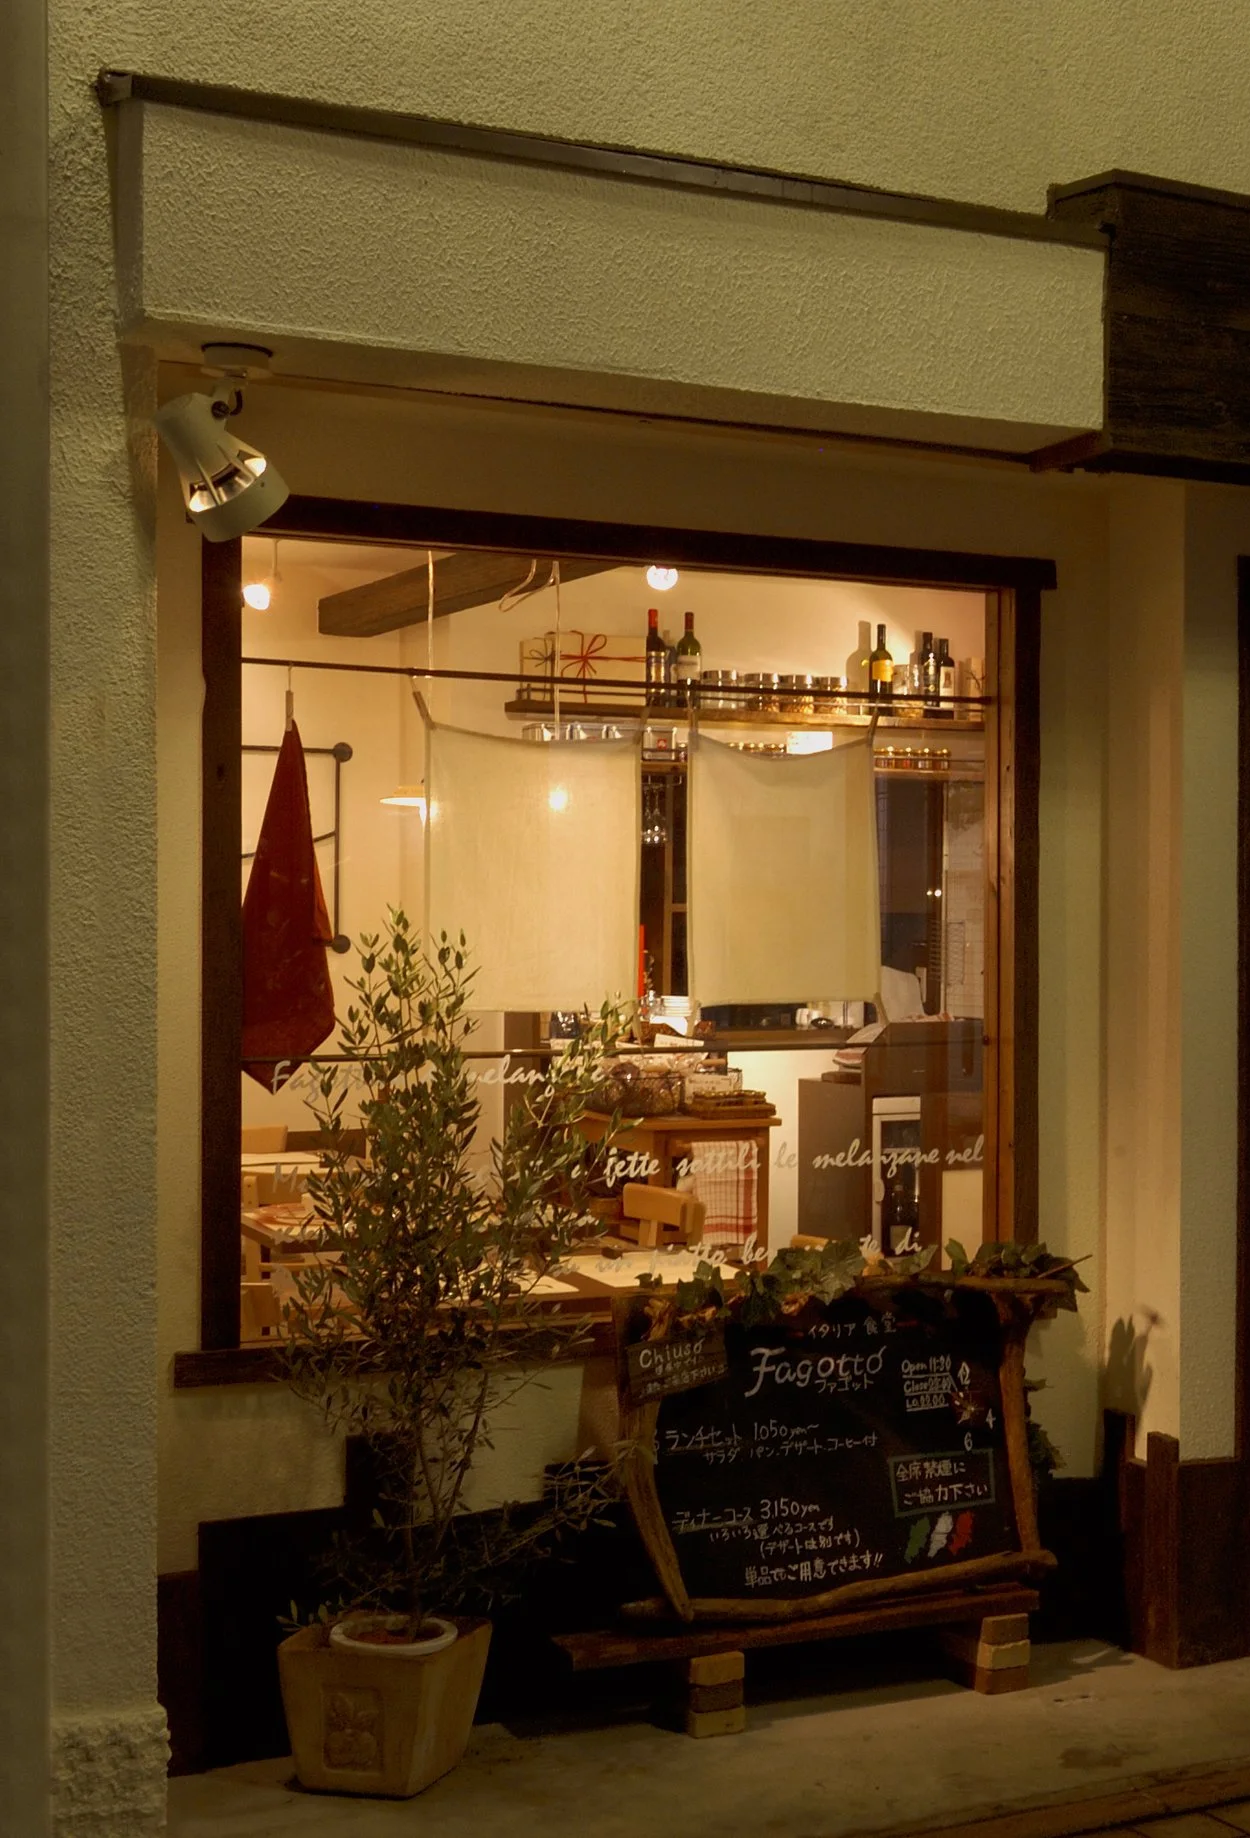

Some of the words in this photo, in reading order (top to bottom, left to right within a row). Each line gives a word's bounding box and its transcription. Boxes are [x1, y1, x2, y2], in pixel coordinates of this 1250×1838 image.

[812, 1138, 940, 1178] melanzane
[945, 1133, 985, 1165] nel
[639, 1336, 706, 1369] Chiuso
[743, 1344, 888, 1398] Fagotto
[901, 1358, 928, 1377] Open
[814, 1373, 875, 1394] ファゴット
[985, 1407, 997, 1430] 4
[665, 1422, 743, 1450] ランチセット
[964, 1431, 974, 1452] 6
[903, 1482, 988, 1506] ご協力下さい
[671, 1506, 754, 1530] ディナーコース
